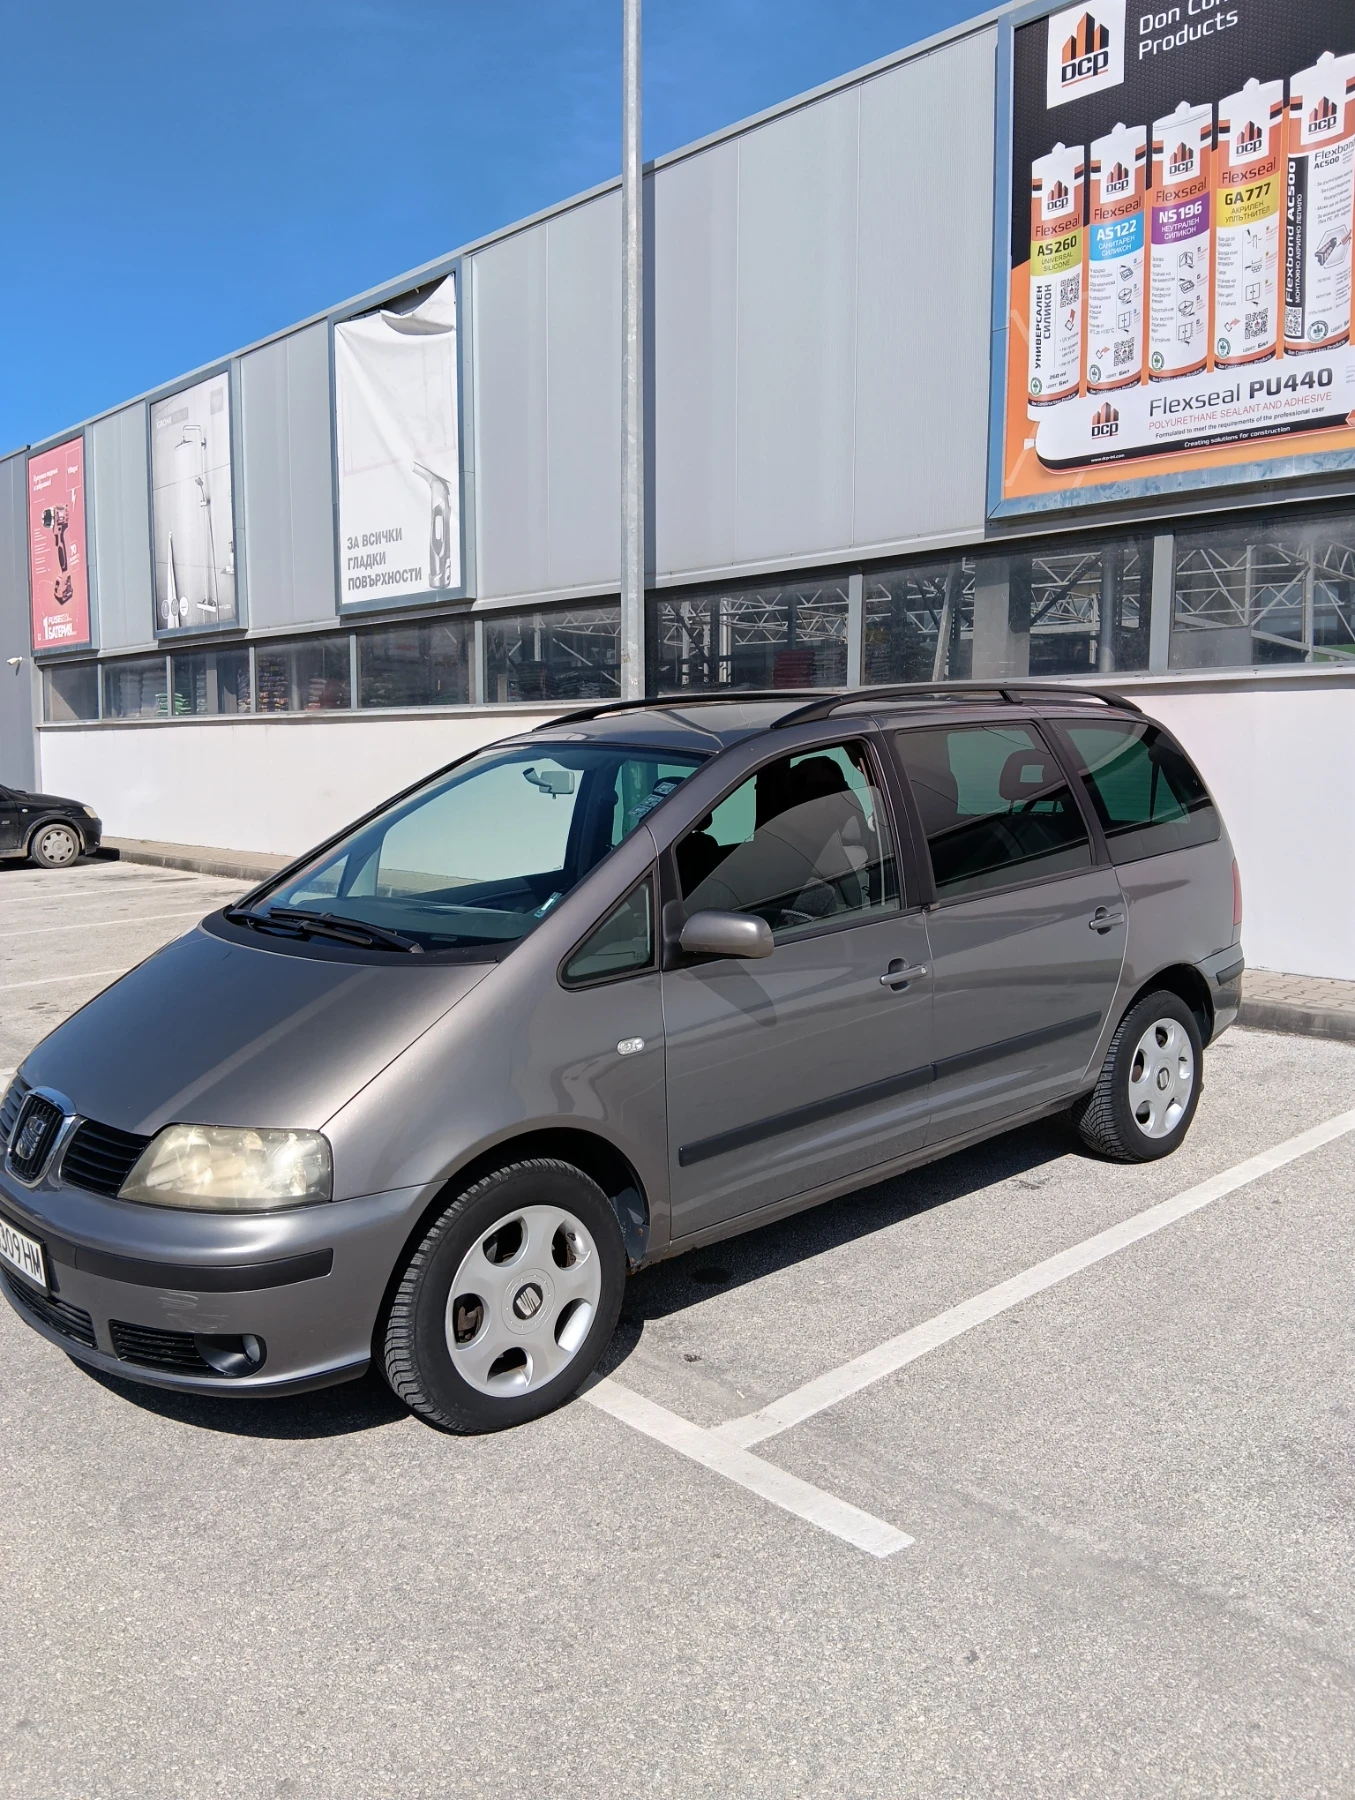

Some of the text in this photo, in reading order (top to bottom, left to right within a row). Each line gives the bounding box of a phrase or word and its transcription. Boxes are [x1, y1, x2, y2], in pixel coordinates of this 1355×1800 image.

[1140, 8, 1179, 35] Don
[1139, 10, 1238, 60] Products
[1222, 157, 1276, 184] Flexseal
[1314, 156, 1340, 170] AC500
[1156, 176, 1207, 202] Flexseal
[1225, 182, 1271, 206] GA777
[1094, 196, 1141, 220] Flexseal
[1159, 200, 1202, 224] NS196
[1225, 205, 1270, 223] УПЛЪТНИТЕЛ
[1231, 200, 1264, 215] АКРИЛЕН
[1035, 213, 1080, 237] Flexseal
[1096, 220, 1137, 241] AS122
[1161, 217, 1200, 233] НЕУТРАЛЕН
[1164, 226, 1196, 240] СИЛИКОН
[1286, 161, 1296, 302] Flexbond AC500
[1037, 235, 1077, 257] AS260
[1098, 235, 1135, 250] САНИТАРЕН
[1101, 243, 1131, 257] СИЛИКОН
[1042, 252, 1073, 265] UNIVERSAL
[1043, 260, 1070, 272] SILICONE
[1043, 284, 1052, 339] СИЛИКОН
[1035, 285, 1043, 369] УНИВЕРСАЛЕН
[1149, 383, 1240, 417] Flexseal
[1249, 368, 1333, 399] PU440
[1149, 391, 1332, 430] POLYURETHANE SEALANT AND ADHESIVE
[1155, 428, 1186, 439] Formulated
[1217, 417, 1254, 429] requirements
[1256, 415, 1262, 423] of
[1263, 413, 1272, 421] the
[1273, 408, 1310, 420] professional
[1184, 438, 1210, 447] Creating
[1210, 433, 1238, 443] solutions
[1250, 426, 1290, 437] construction
[347, 527, 402, 550] ЗА ВСИЧКИ
[347, 551, 386, 570] ГЛАДКИ
[348, 566, 422, 591] ПОВЪРХНОСТИ
